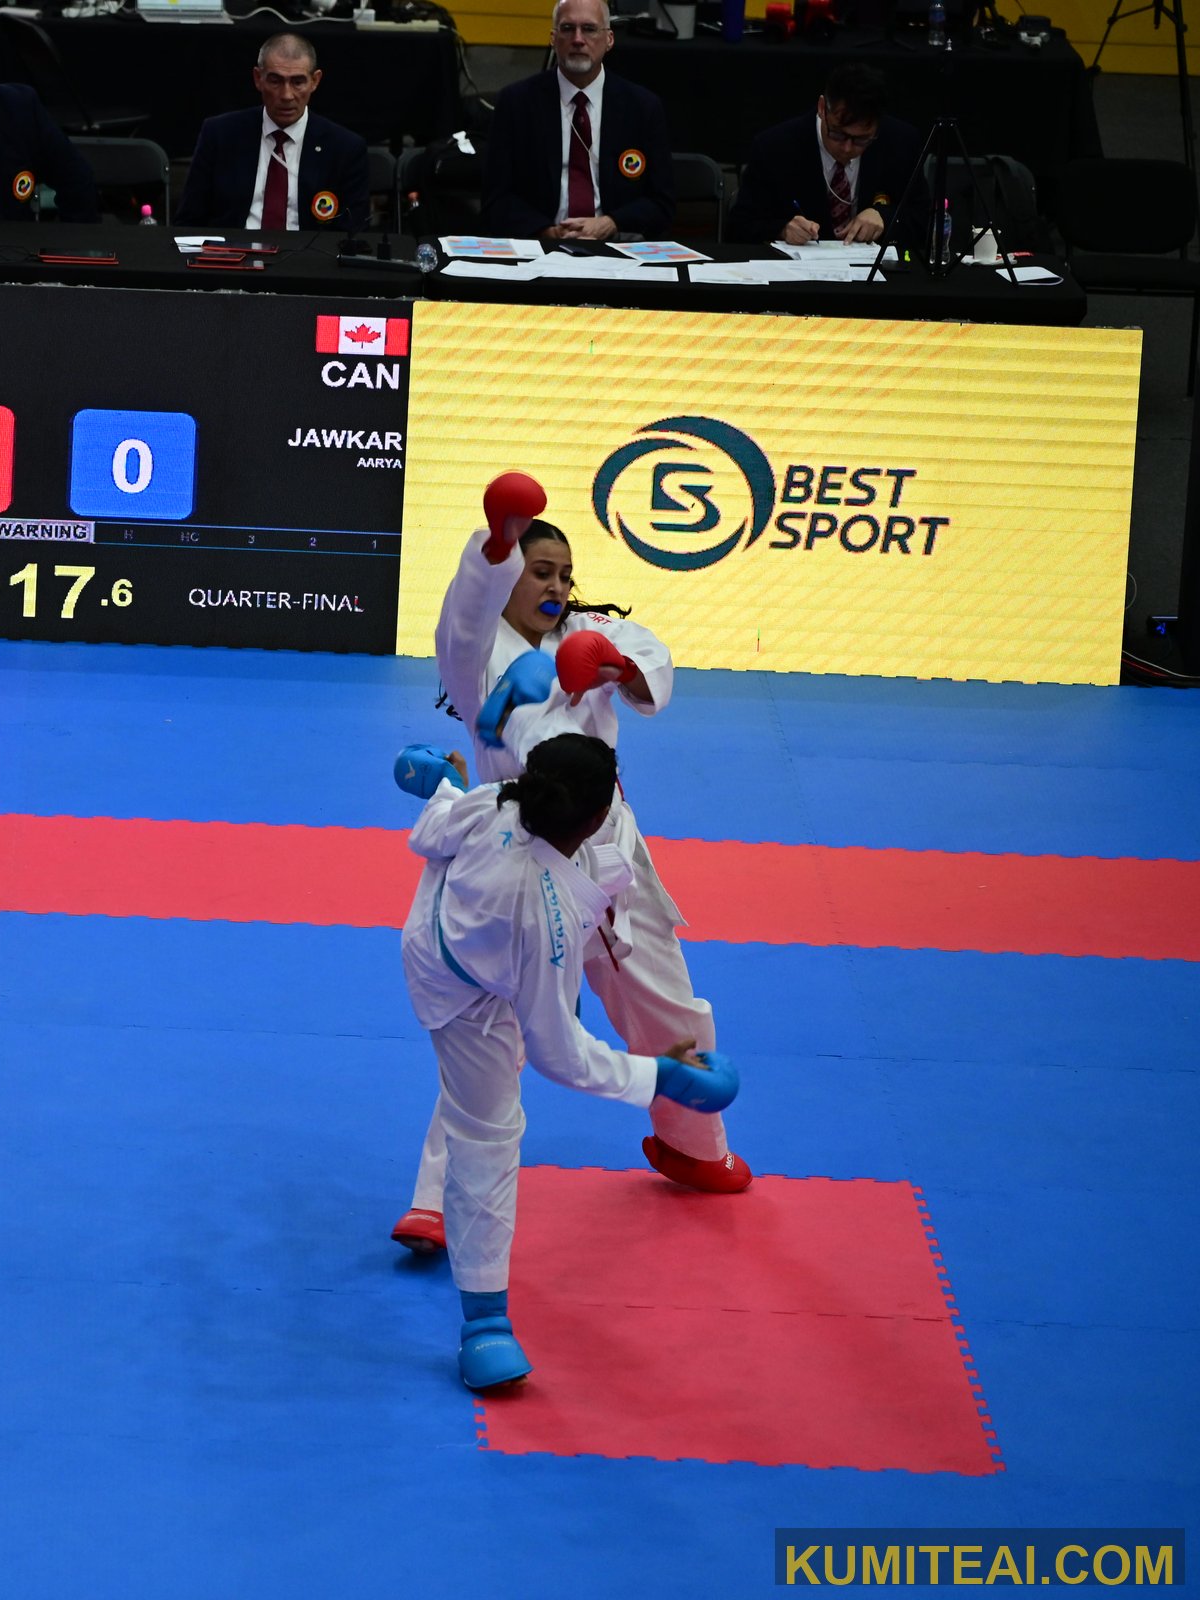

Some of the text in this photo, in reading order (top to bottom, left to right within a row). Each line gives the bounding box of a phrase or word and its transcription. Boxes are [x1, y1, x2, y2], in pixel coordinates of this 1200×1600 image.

[321, 361, 400, 390] CAN
[288, 427, 403, 451] JAWKAR
[112, 438, 154, 494] 0
[356, 457, 403, 469] AARYA
[780, 464, 917, 508] BEST
[309, 536, 319, 547] 2
[768, 511, 950, 556] SPORT
[188, 588, 365, 612] QUARTER-FINAL
